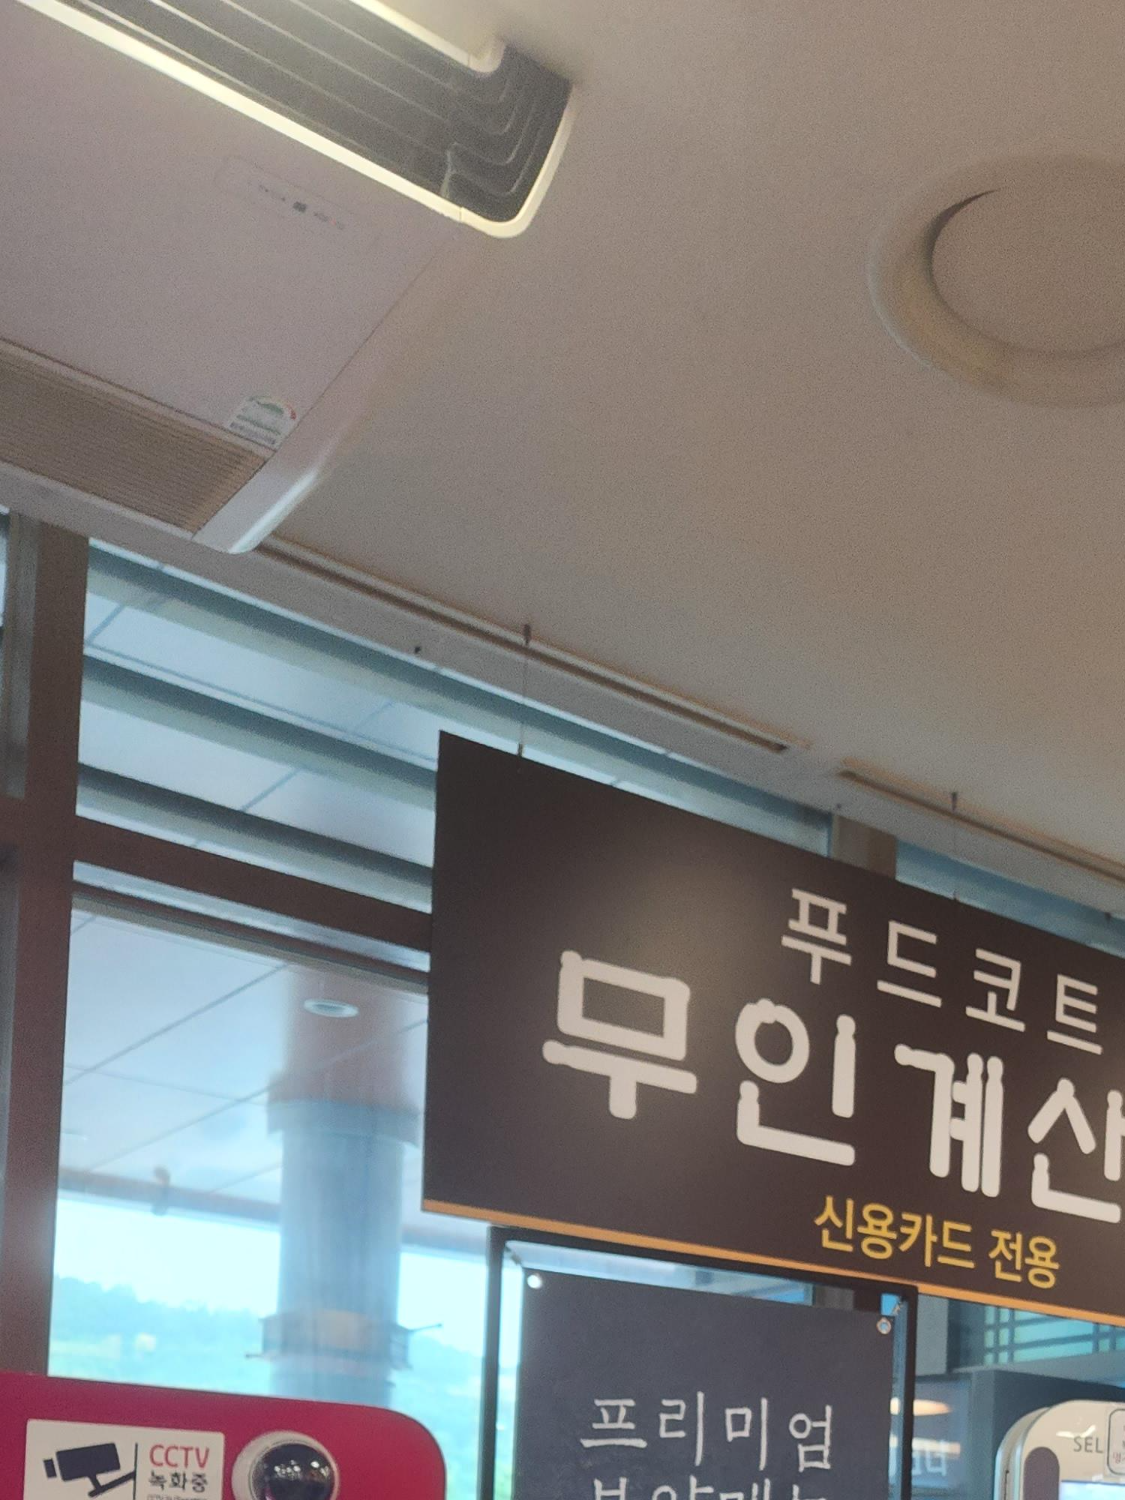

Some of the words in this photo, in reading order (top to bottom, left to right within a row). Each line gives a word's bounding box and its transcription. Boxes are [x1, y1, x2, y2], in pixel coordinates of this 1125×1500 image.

[781, 888, 1102, 1055] 푸드코트
[814, 1196, 976, 1271] 신용카드
[989, 1227, 1060, 1290] 전용
[149, 1444, 210, 1468] CCTV
[580, 1391, 832, 1472] 프리미엄
[1073, 1436, 1104, 1454] SEL
